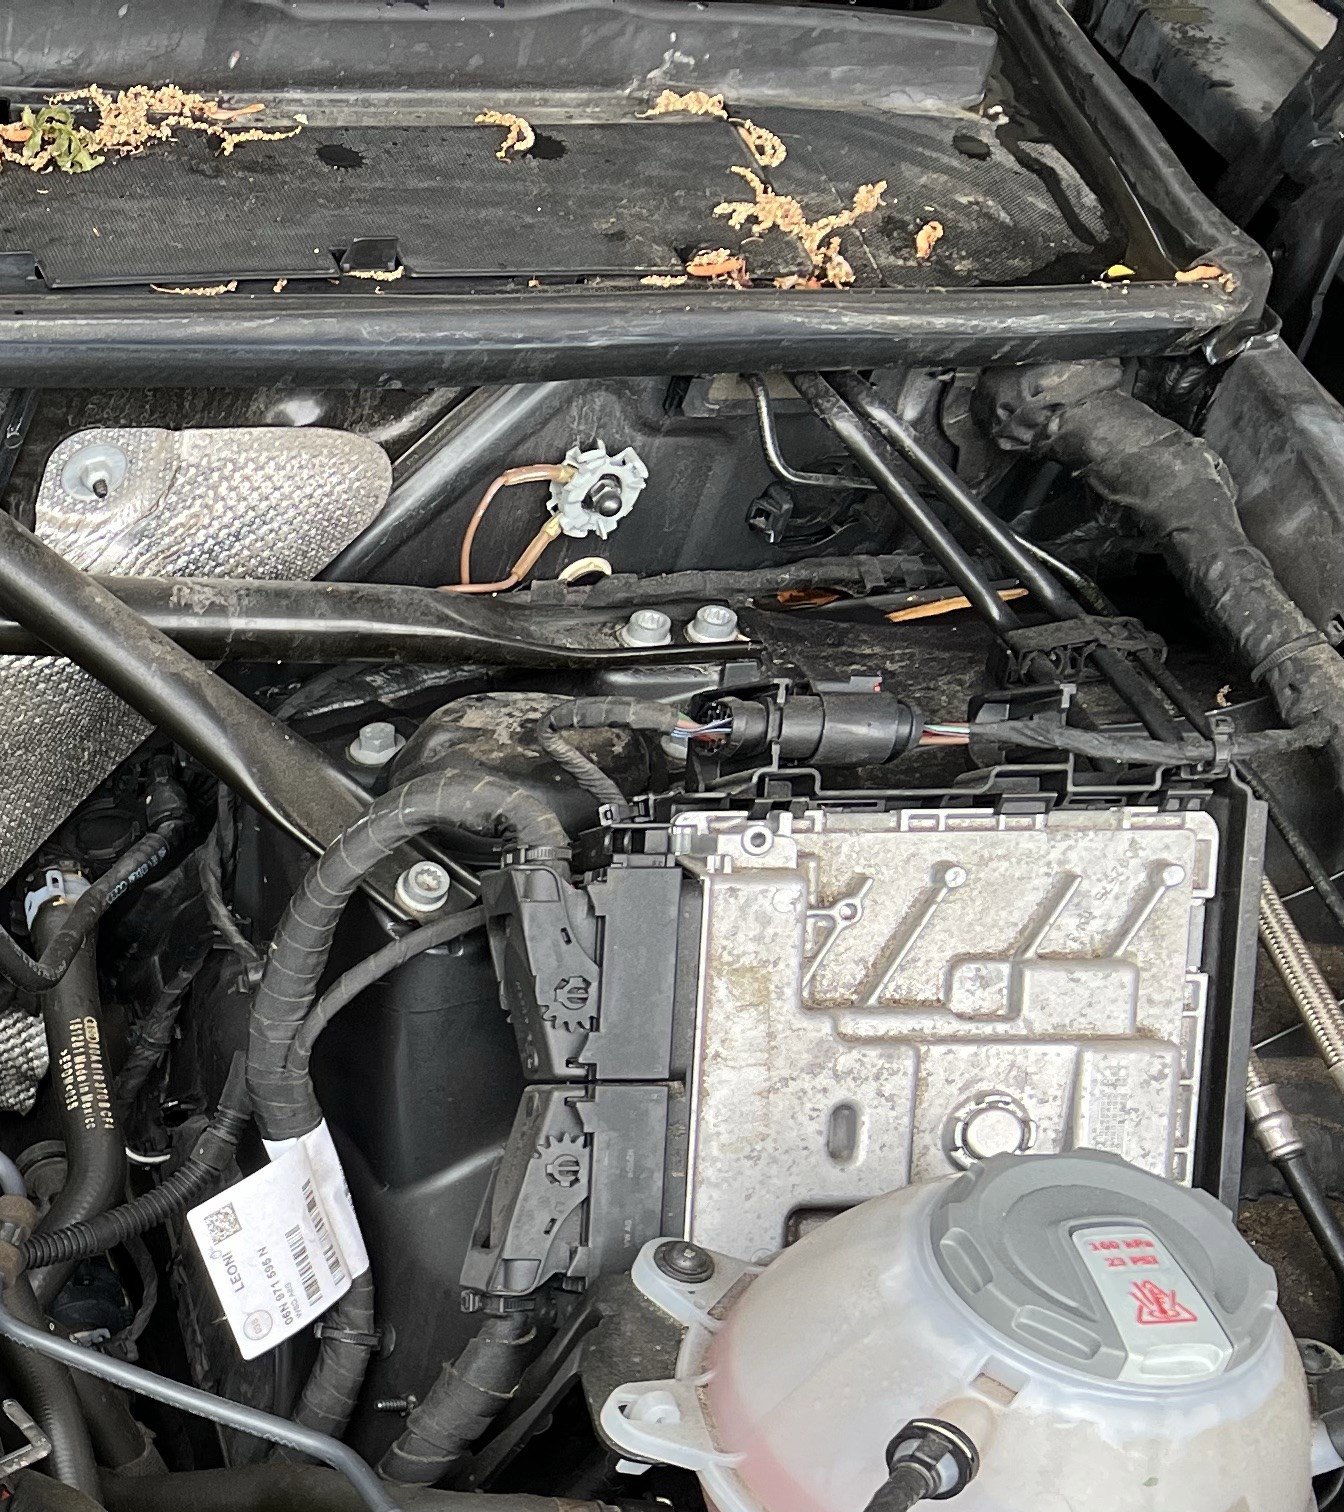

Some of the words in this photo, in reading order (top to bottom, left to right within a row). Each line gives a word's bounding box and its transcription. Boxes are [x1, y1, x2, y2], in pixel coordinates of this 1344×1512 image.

[73, 1055, 87, 1081] Made
[79, 1082, 90, 1094] in
[81, 1094, 96, 1129] Mexico
[257, 1246, 267, 1257] N
[222, 1253, 245, 1293] LEONI
[278, 1304, 294, 1326] 06N
